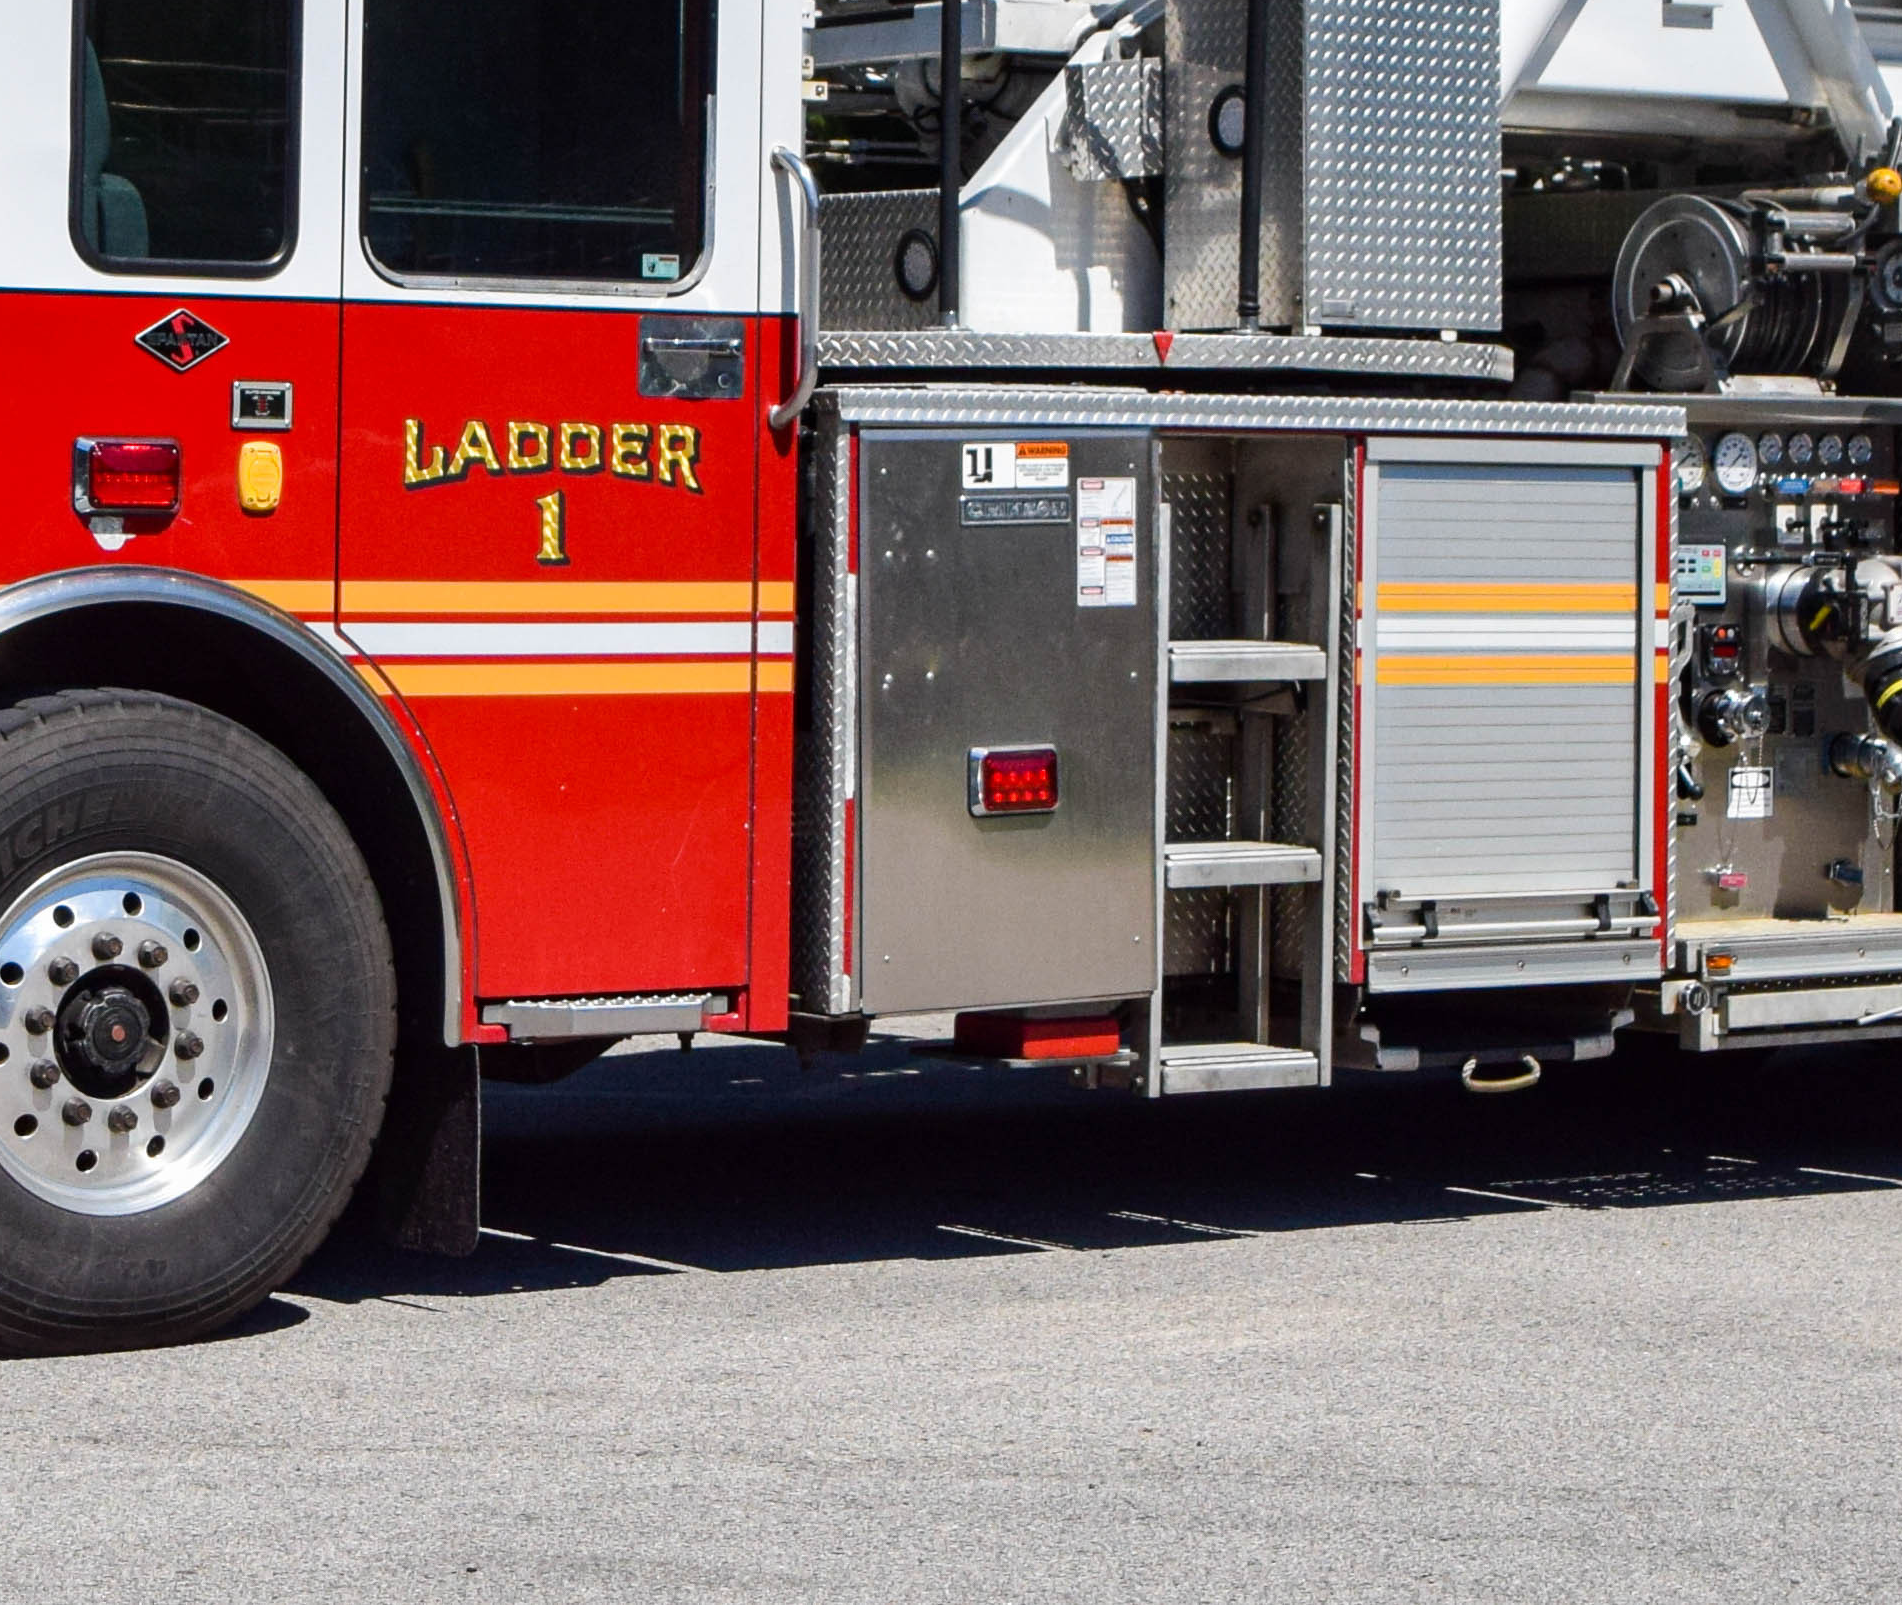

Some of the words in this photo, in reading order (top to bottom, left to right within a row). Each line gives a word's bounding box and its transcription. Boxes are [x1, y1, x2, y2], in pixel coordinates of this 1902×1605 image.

[147, 332, 218, 346] SPARTAN
[404, 419, 703, 495] LADDER
[536, 489, 570, 565] 1
